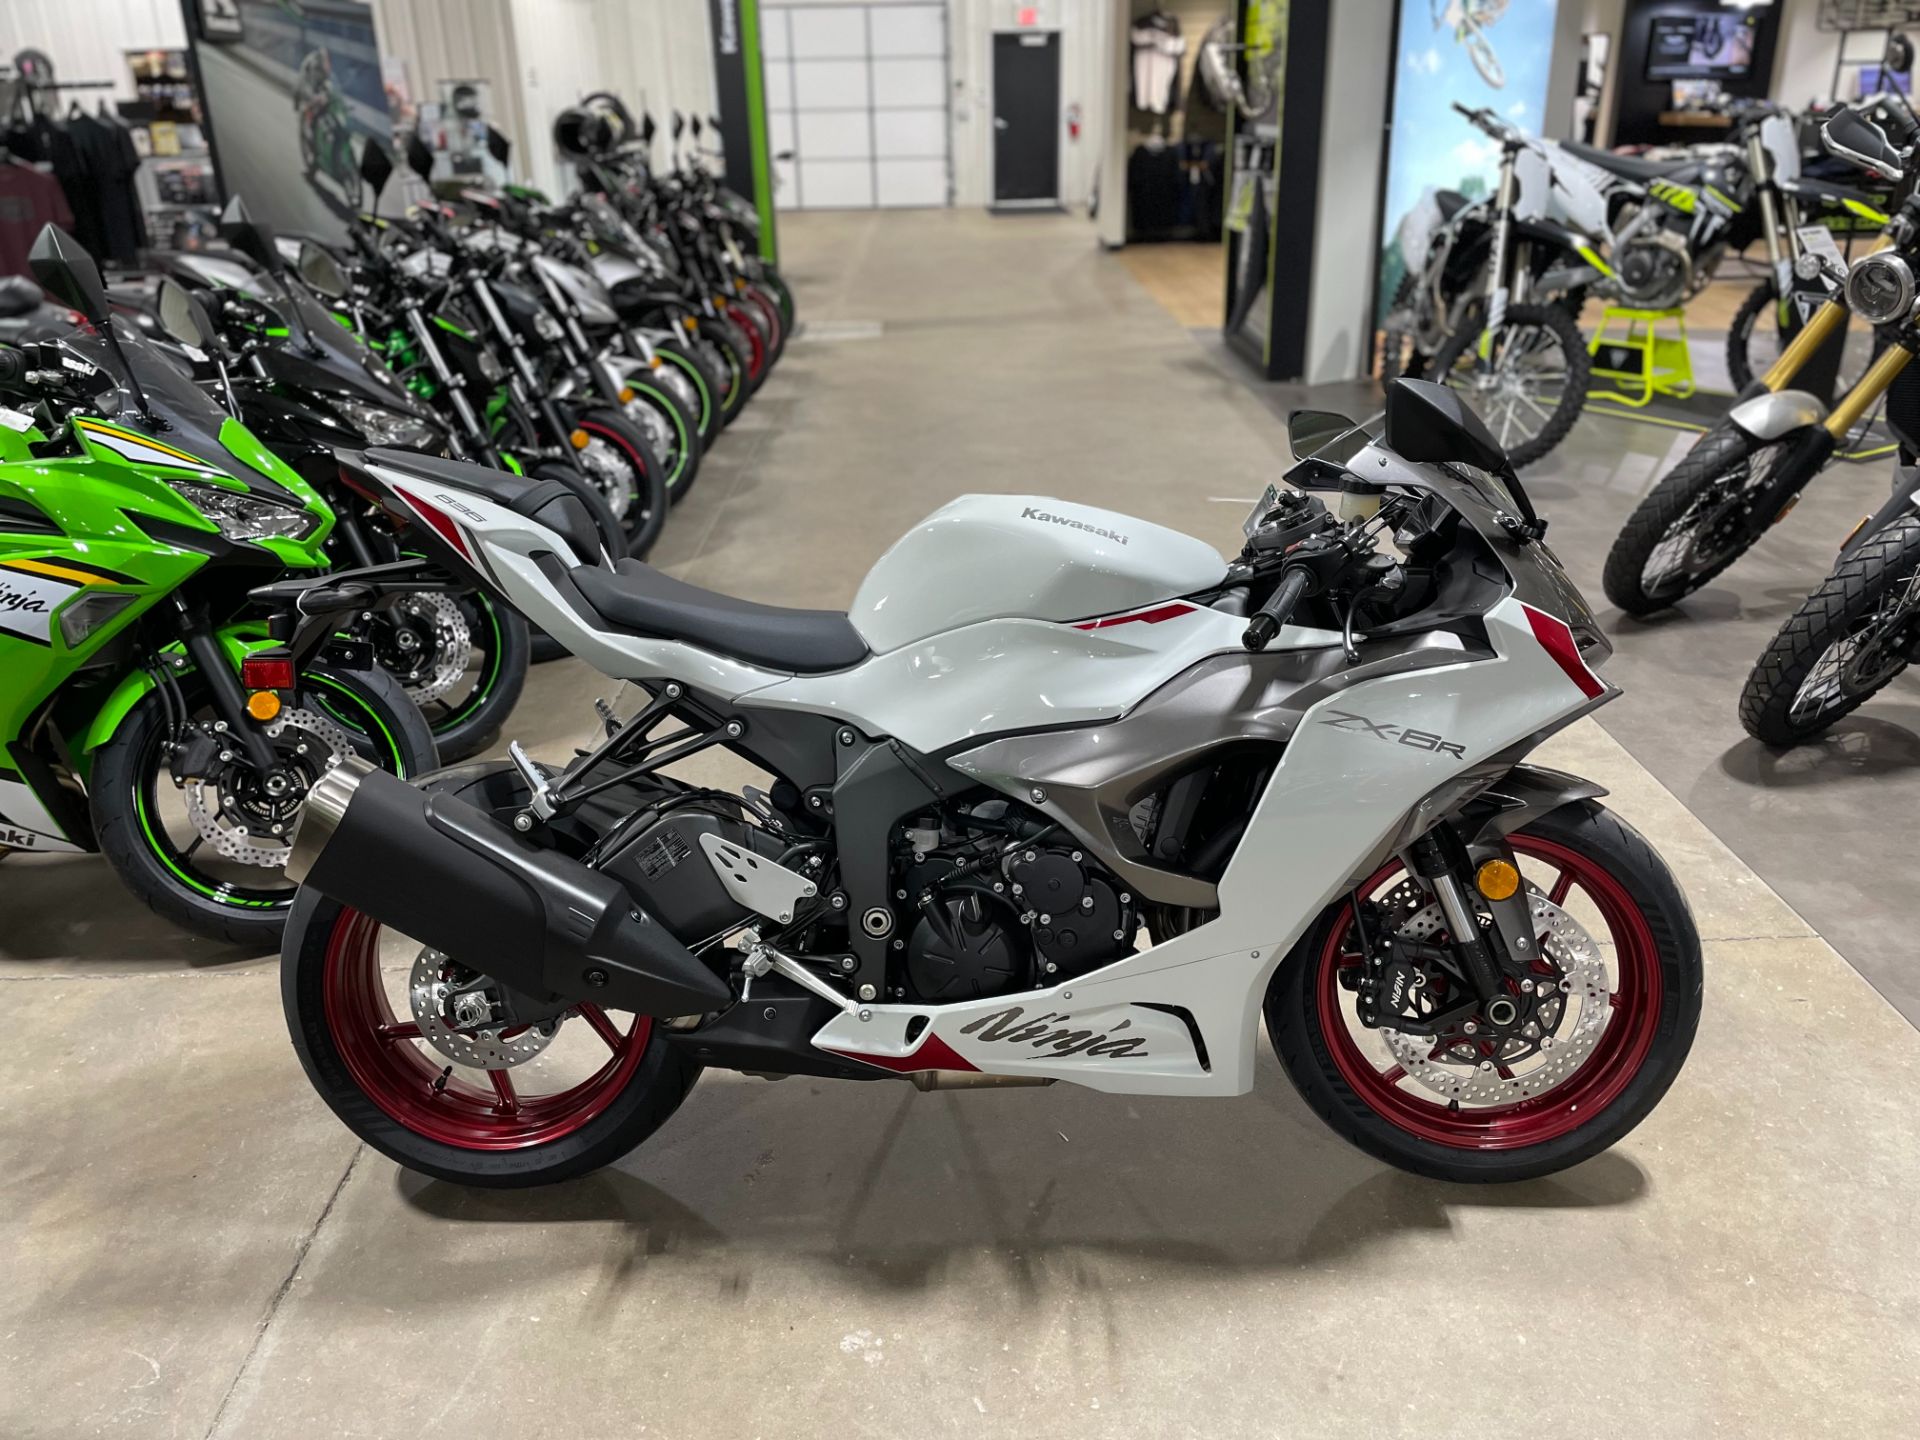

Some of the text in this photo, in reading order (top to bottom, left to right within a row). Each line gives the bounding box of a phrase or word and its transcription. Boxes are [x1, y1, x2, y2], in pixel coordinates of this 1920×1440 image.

[434, 494, 488, 522] 636
[1021, 507, 1129, 546] Kawasaki
[1317, 710, 1467, 760] ZX-6R
[959, 1006, 1149, 1060] Ninja
